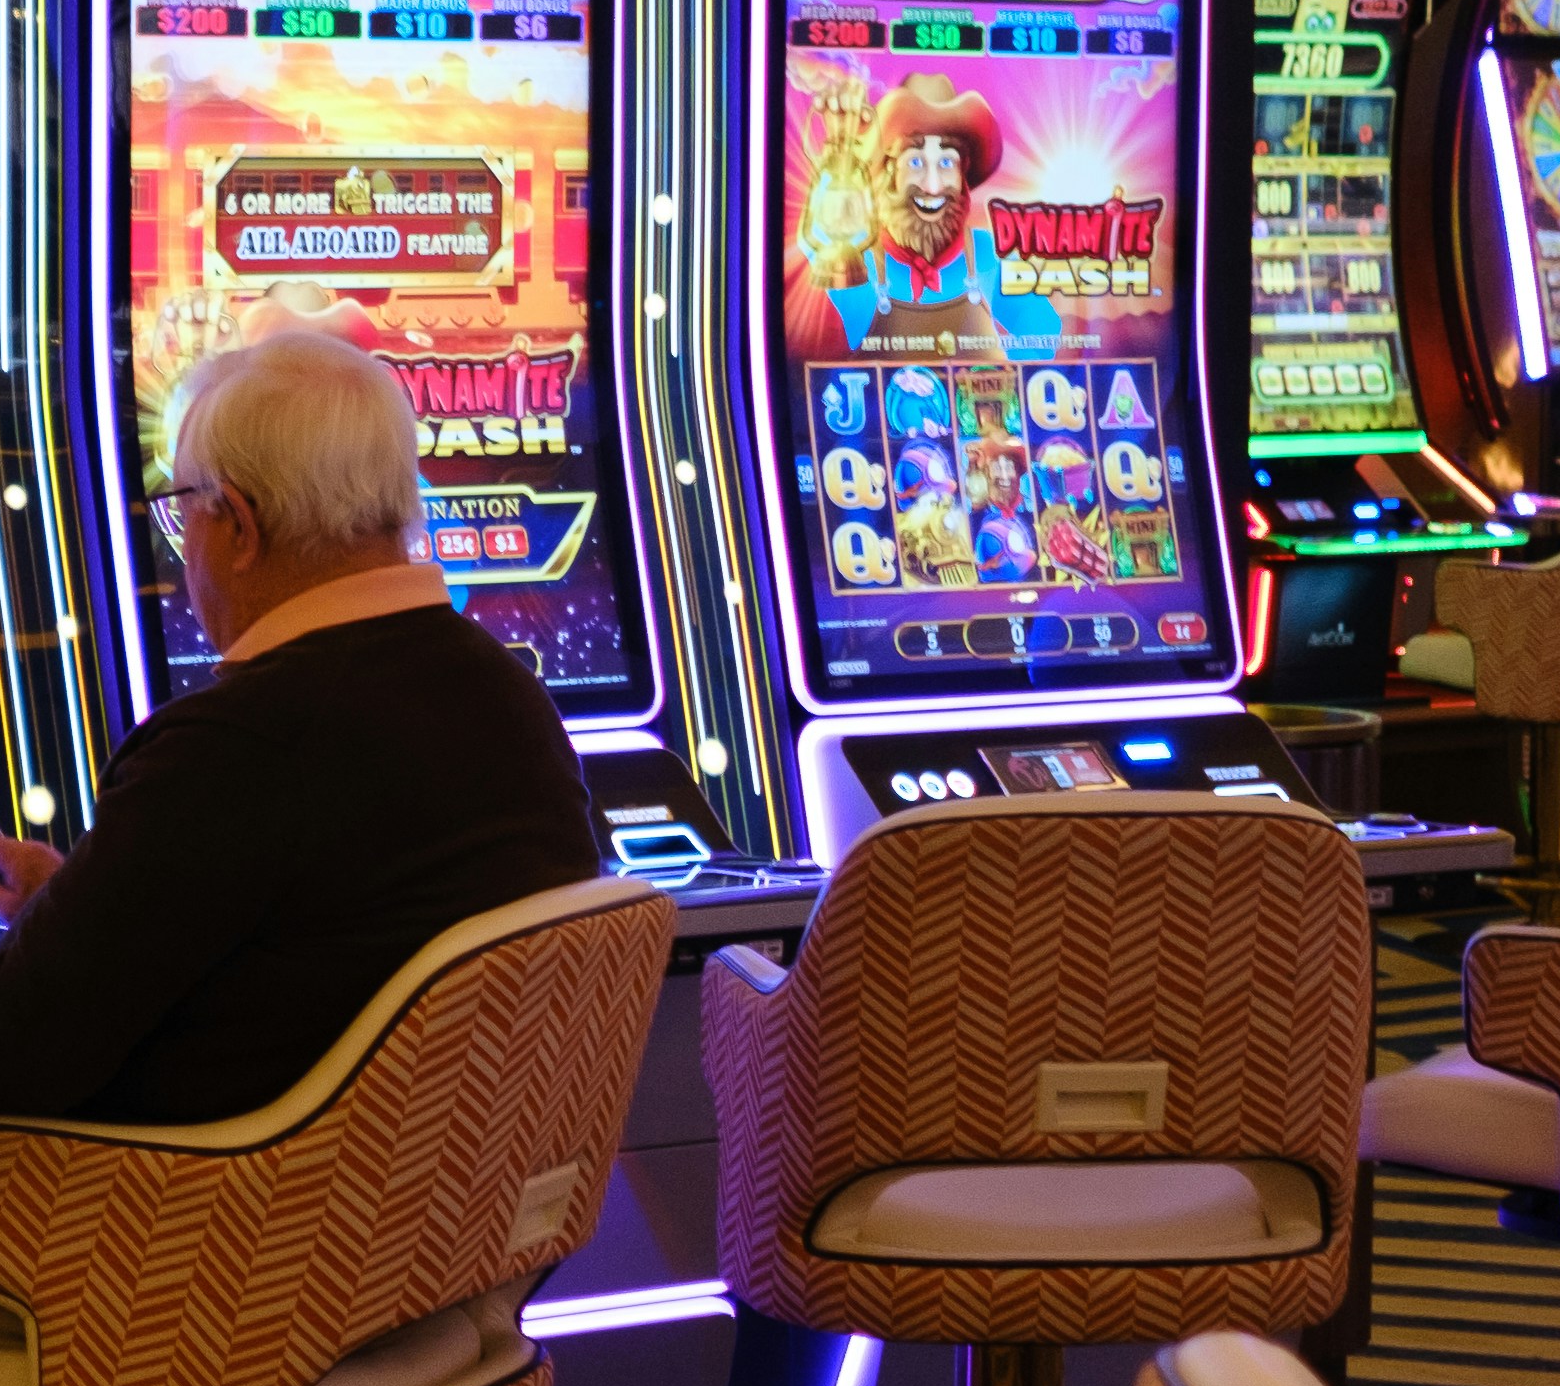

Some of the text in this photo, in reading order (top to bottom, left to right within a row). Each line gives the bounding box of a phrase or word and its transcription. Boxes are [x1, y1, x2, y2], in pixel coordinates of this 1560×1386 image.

[157, 8, 228, 35] $200
[282, 10, 335, 37] $50
[395, 13, 447, 38] $10
[514, 15, 548, 40] $6
[808, 21, 869, 46] $200
[915, 24, 960, 49] $50
[1012, 27, 1057, 52] $10
[1115, 31, 1144, 54] $6
[225, 192, 494, 215] 6 OR MORE TRIGGER THE
[239, 227, 489, 258] ALL ABOARD FEATURE
[990, 200, 1161, 260] DYNAMITE
[1000, 257, 1151, 298] DASH
[823, 372, 870, 435] J
[1026, 369, 1087, 431] Q
[1098, 368, 1155, 429] A
[822, 447, 886, 510] Q
[1102, 441, 1163, 503] Q
[421, 498, 520, 520] INATION
[441, 534, 476, 556] 25¢
[494, 532, 518, 554] $1
[832, 521, 896, 585] Q
[1011, 624, 1025, 646] 0
